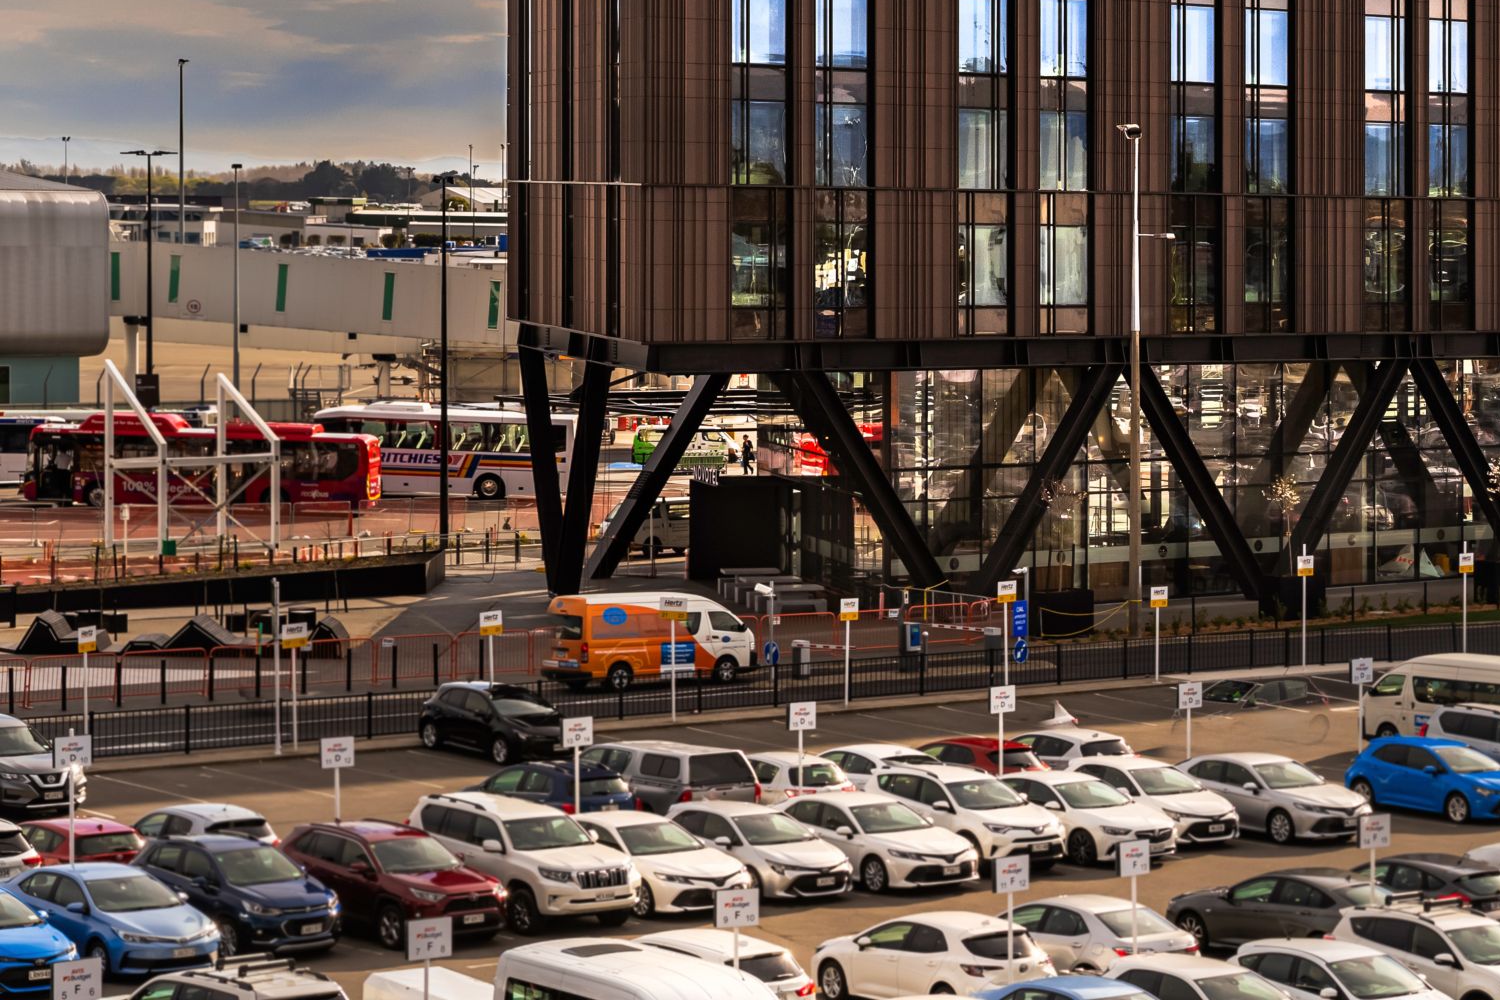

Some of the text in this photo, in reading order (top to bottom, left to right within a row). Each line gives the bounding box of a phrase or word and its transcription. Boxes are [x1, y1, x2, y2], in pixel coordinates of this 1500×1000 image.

[693, 465, 719, 486] NOVOTEL
[123, 481, 155, 492] 100%
[286, 626, 304, 634] Hertz
[335, 754, 341, 762] D
[1133, 861, 1137, 869] F
[1010, 877, 1015, 885] F
[723, 911, 756, 923] 9 F 10
[427, 941, 433, 951] F
[72, 973, 93, 982] Budget
[62, 984, 96, 1000] 5 F 6
